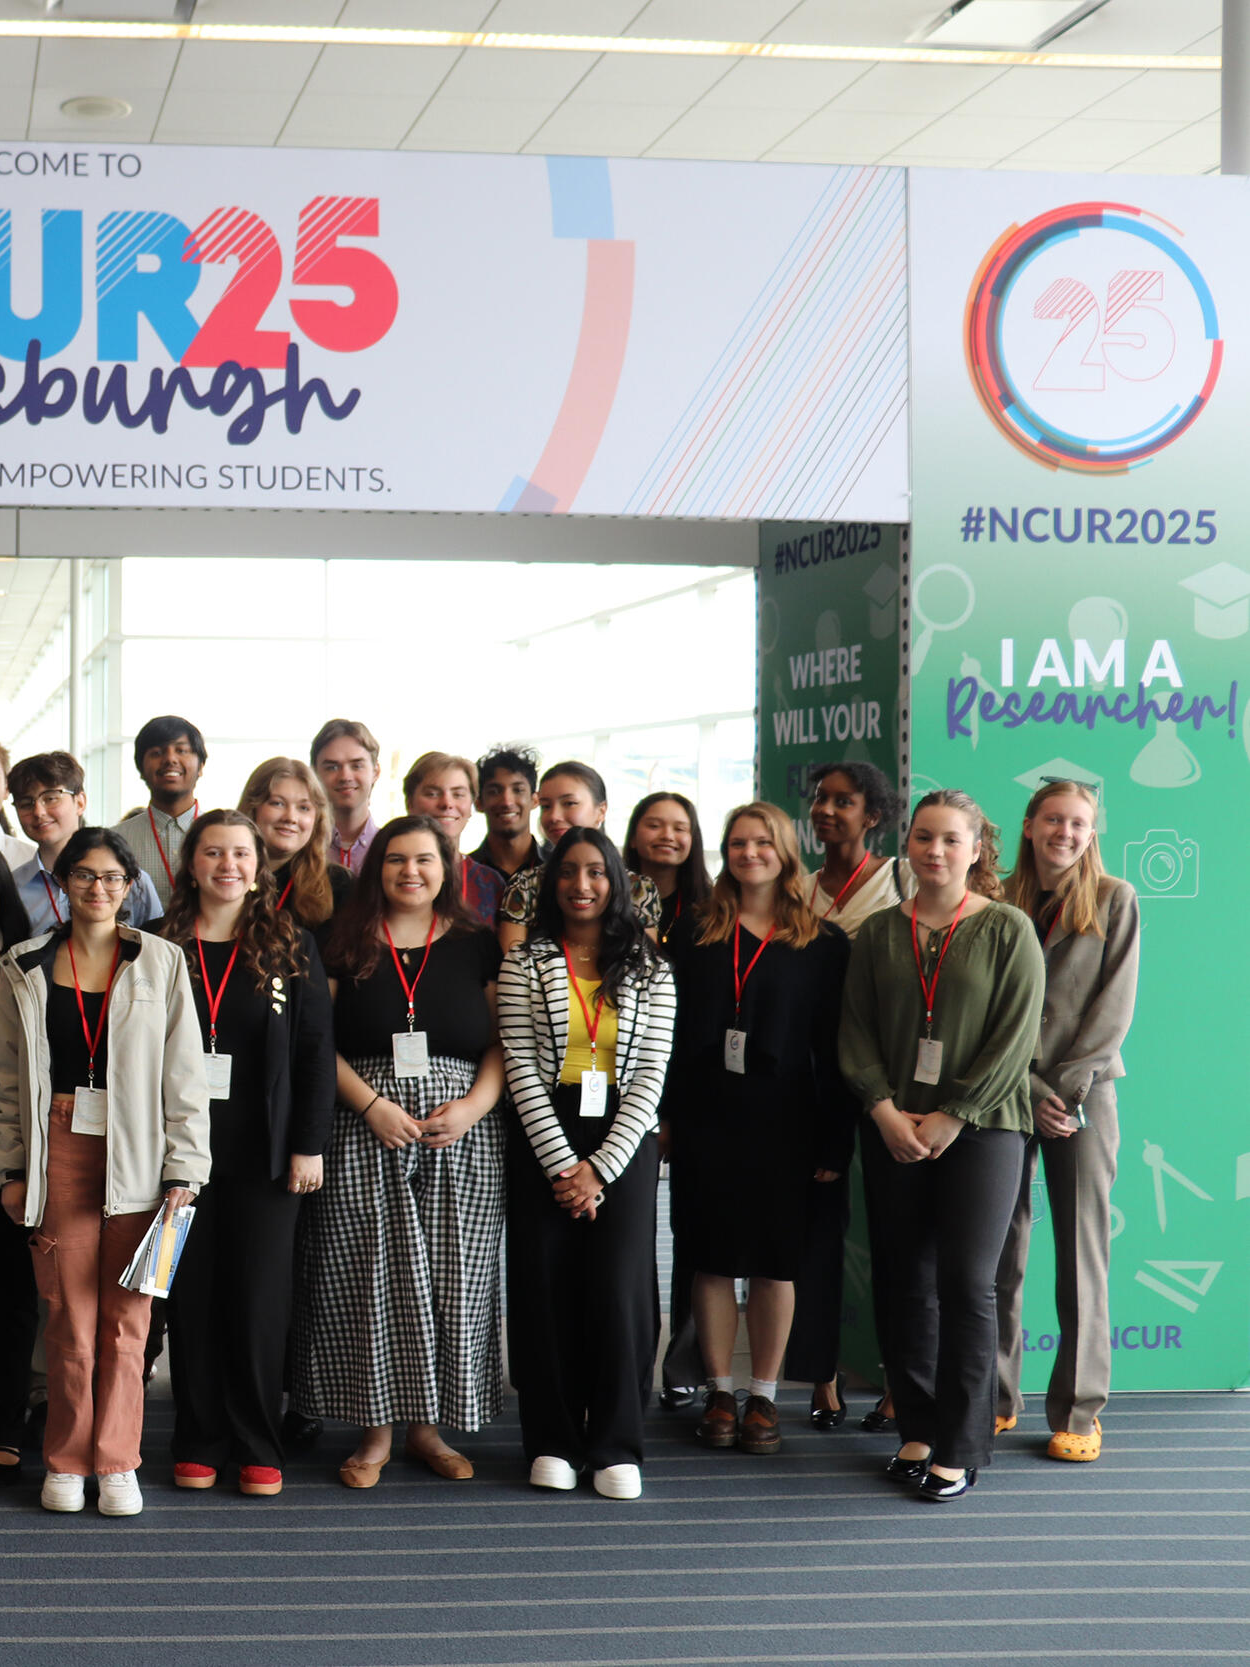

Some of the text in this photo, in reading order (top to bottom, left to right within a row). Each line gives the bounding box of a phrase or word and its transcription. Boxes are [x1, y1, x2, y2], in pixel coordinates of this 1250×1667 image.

[98, 153, 142, 178] TO
[1033, 269, 1176, 392] 25
[218, 465, 392, 492] STUDENTS.
[960, 507, 1217, 545] #NCUR2025
[775, 523, 881, 576] #NCUR2025
[789, 644, 862, 690] WHERE
[1001, 638, 1184, 688] I AM A
[773, 701, 882, 746] WILL YOUR
[946, 676, 1238, 740] Researcher!
